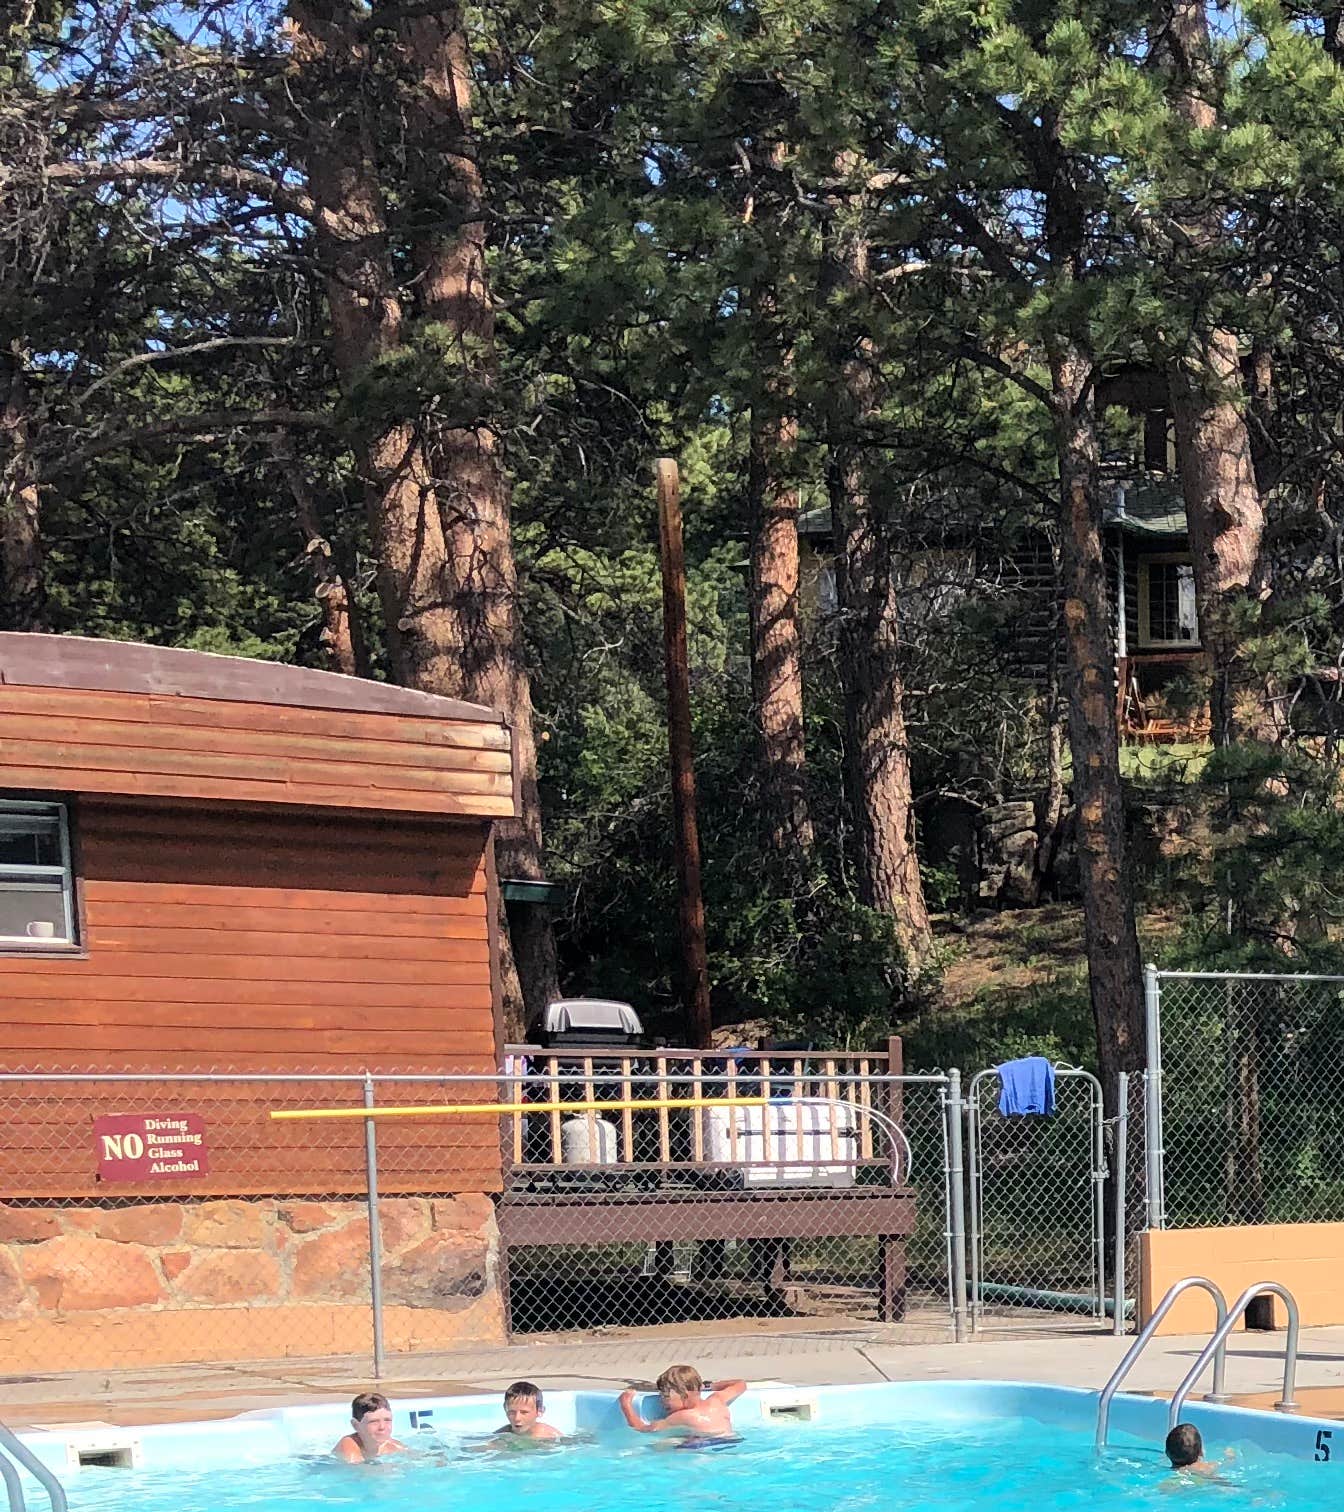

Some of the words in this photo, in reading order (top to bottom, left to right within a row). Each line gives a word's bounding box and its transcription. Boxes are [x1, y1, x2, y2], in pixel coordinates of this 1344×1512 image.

[144, 1118, 188, 1132] Diving
[146, 1132, 202, 1145] Running
[101, 1133, 144, 1161] NO
[148, 1147, 184, 1159] Glass
[149, 1160, 200, 1173] Alcohol
[1314, 1430, 1332, 1462] 5
